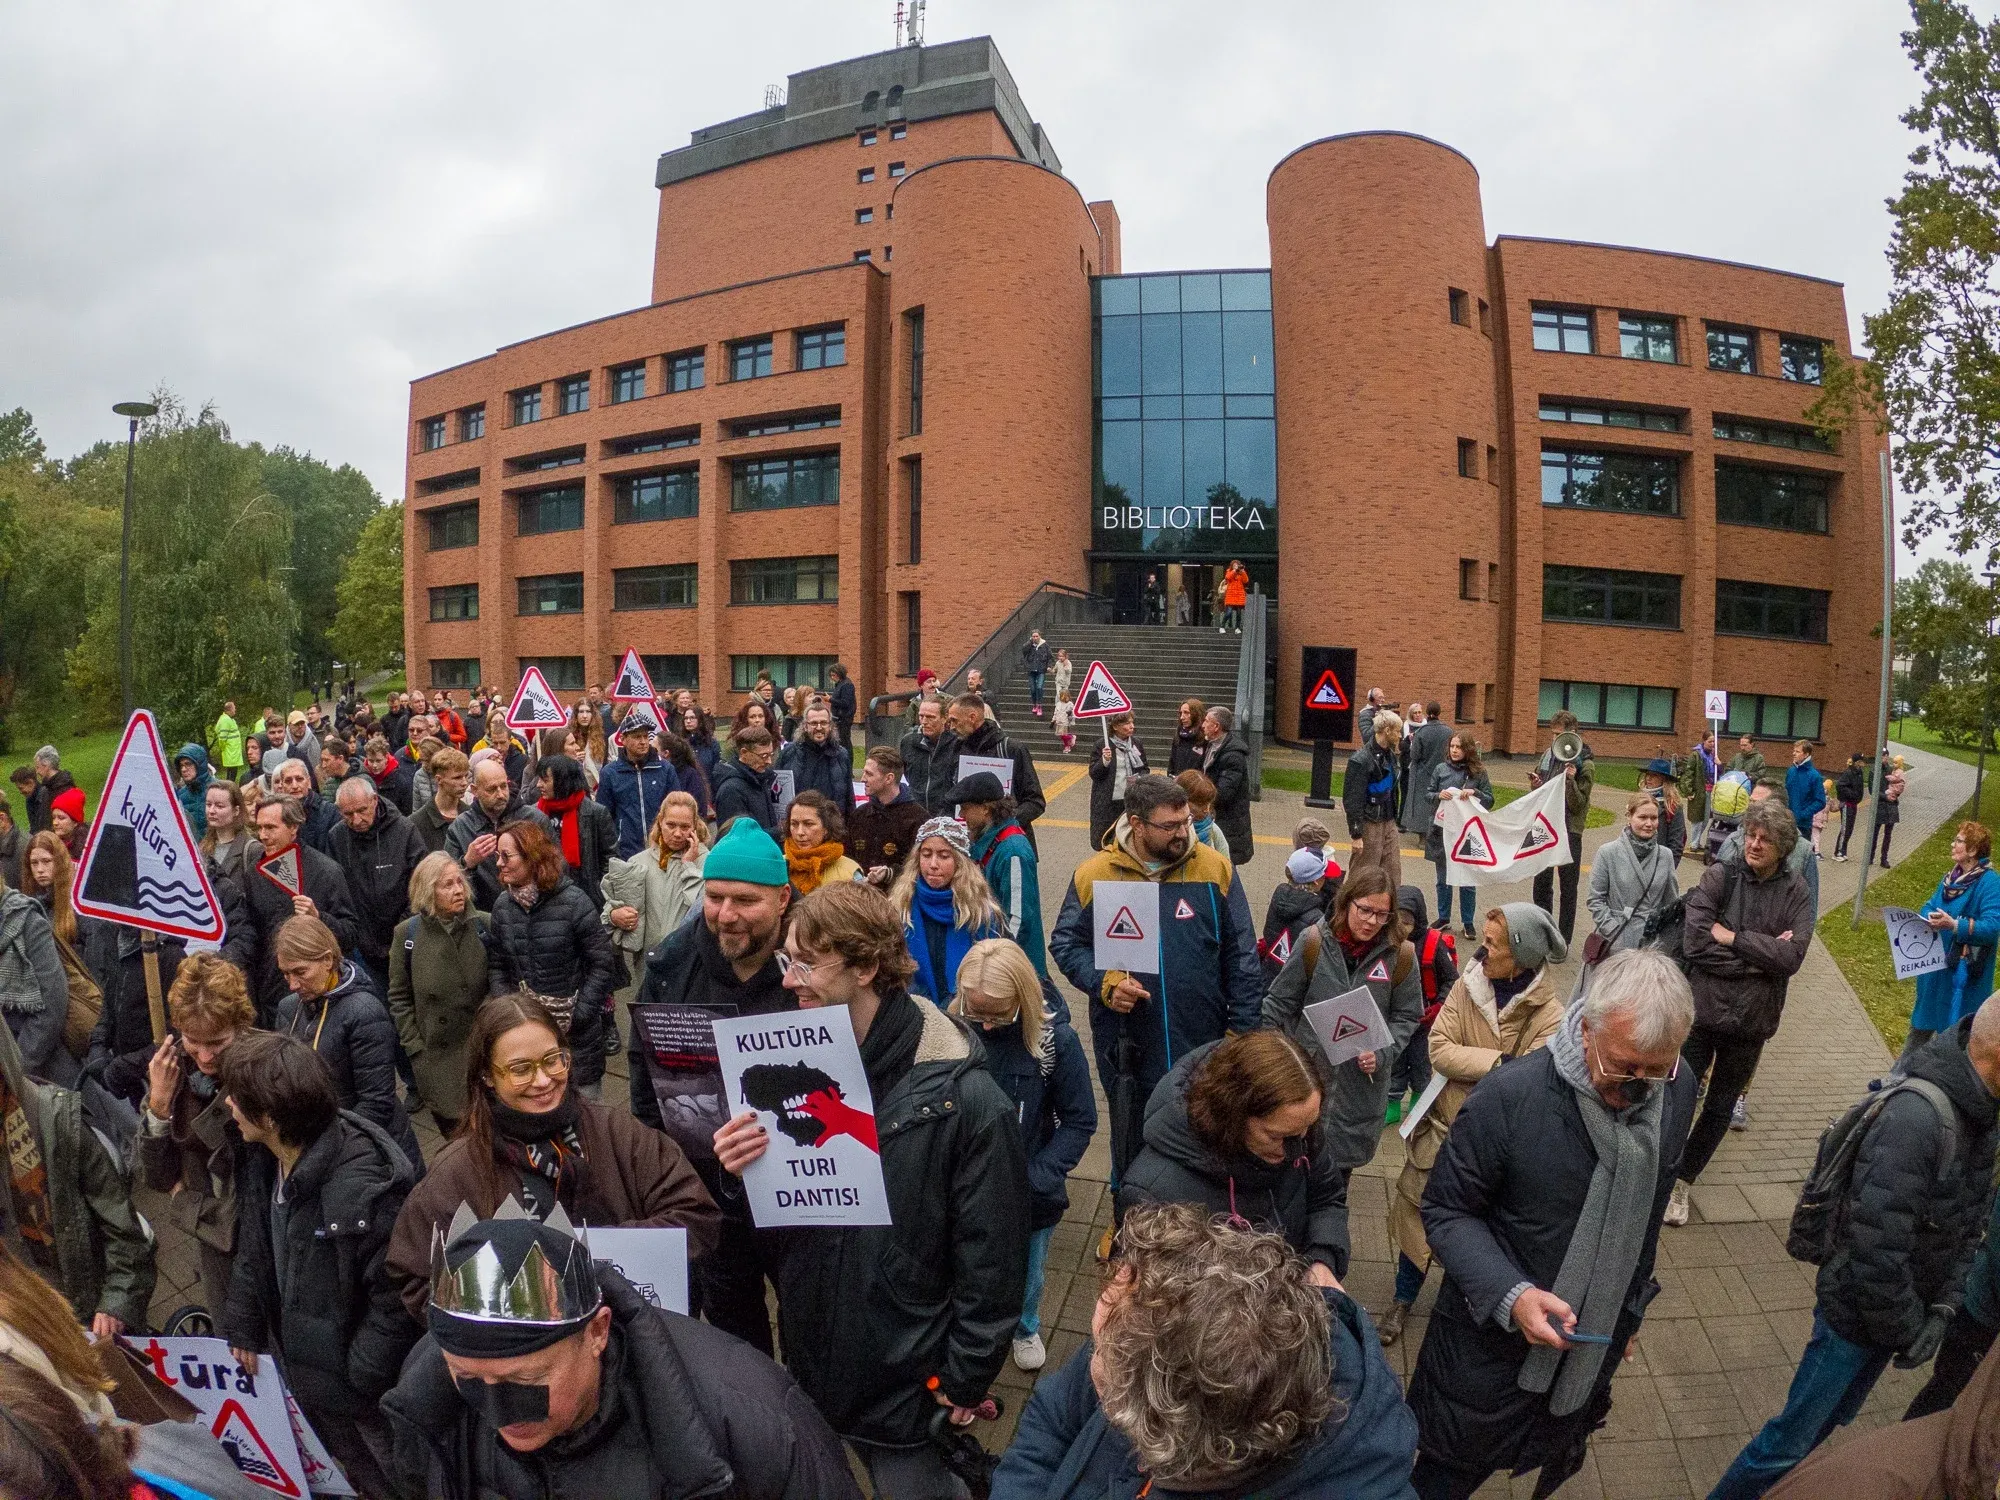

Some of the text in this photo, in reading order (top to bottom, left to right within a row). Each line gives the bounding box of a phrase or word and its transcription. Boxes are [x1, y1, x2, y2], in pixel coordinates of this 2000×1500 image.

[1103, 506, 1265, 530] BIBLIOTEKA
[525, 687, 550, 708] kultūra
[1091, 680, 1114, 696] kultūra
[119, 785, 178, 871] kultūra
[735, 1025, 834, 1053] KULTŪRA
[786, 1157, 837, 1178] TURI
[775, 1187, 860, 1208] DANTIS!
